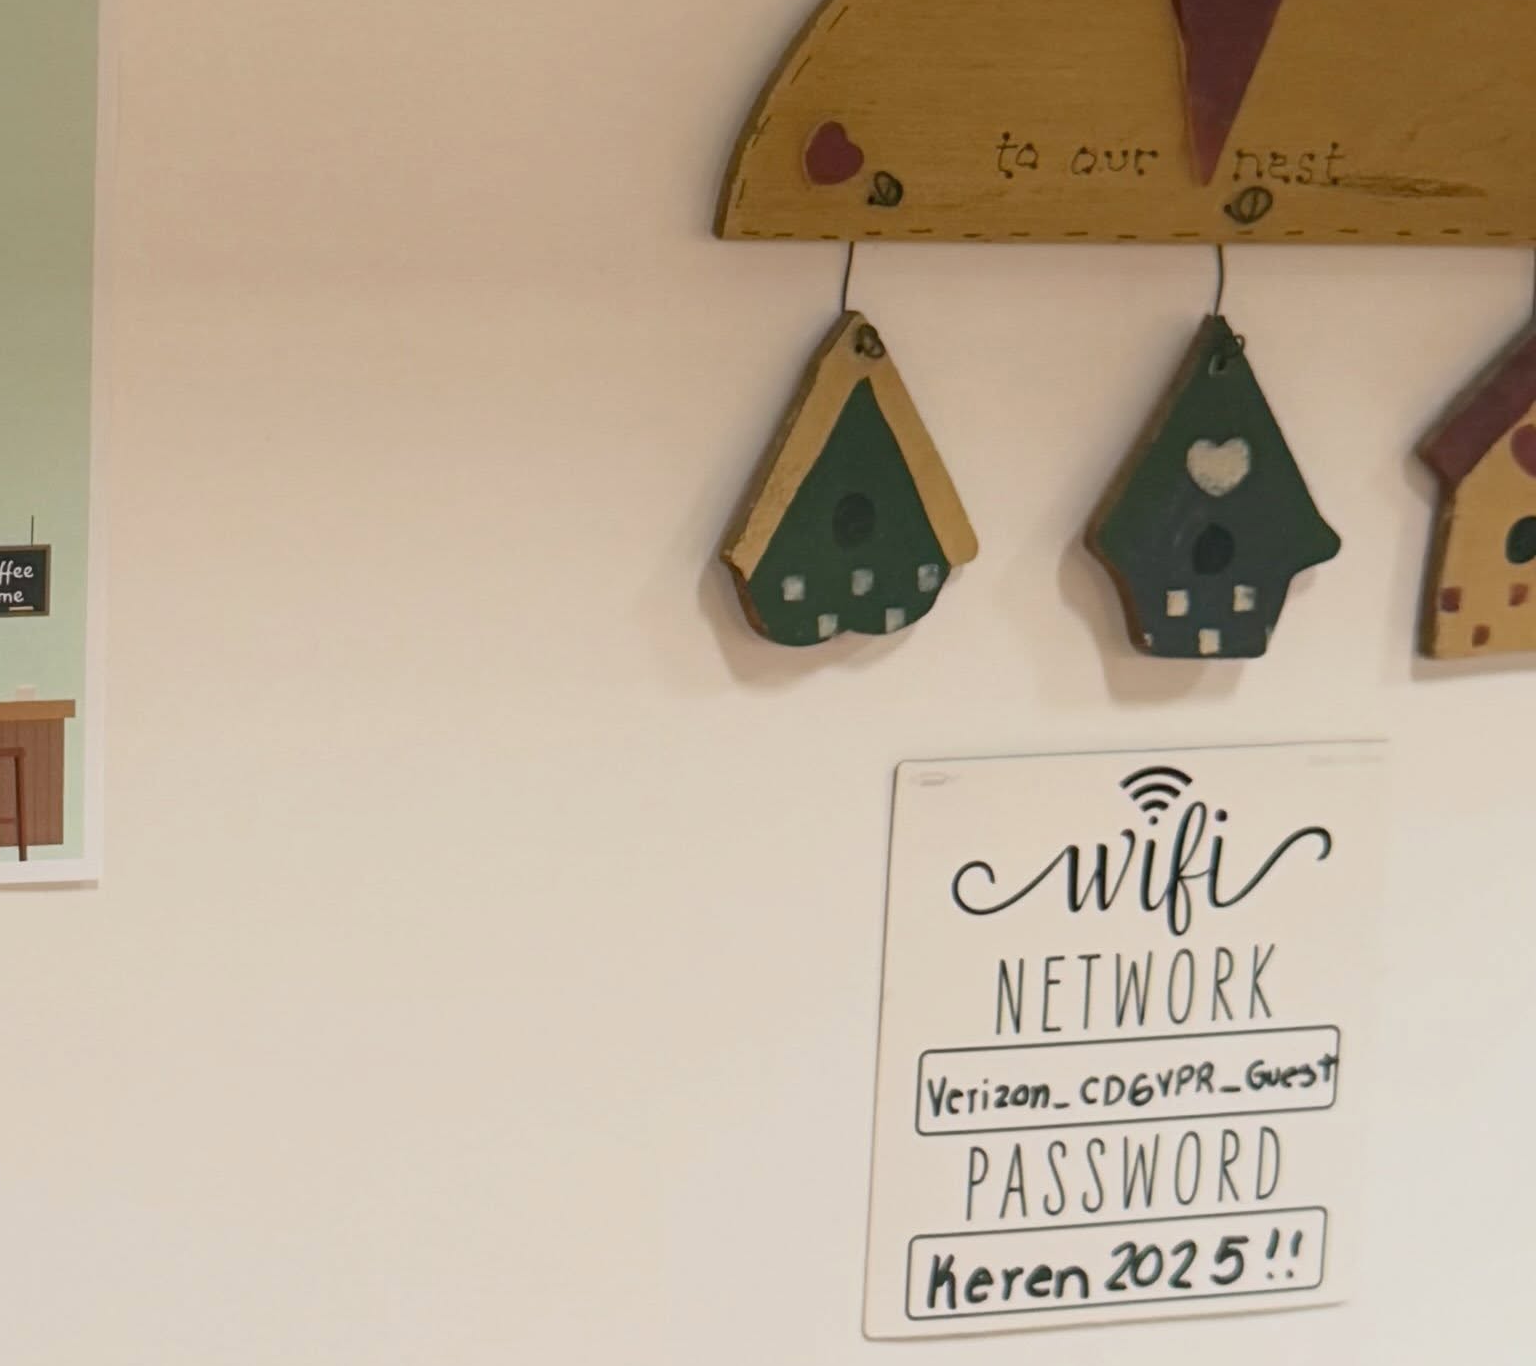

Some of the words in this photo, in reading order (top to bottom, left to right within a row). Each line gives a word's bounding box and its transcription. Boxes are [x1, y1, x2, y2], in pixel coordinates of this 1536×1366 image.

[996, 131, 1040, 179] to
[1071, 146, 1160, 177] our
[1231, 141, 1346, 186] nest
[952, 801, 1332, 937] wifi
[995, 943, 1276, 1036] NETWORK
[966, 1125, 1282, 1221] PASSWORD
